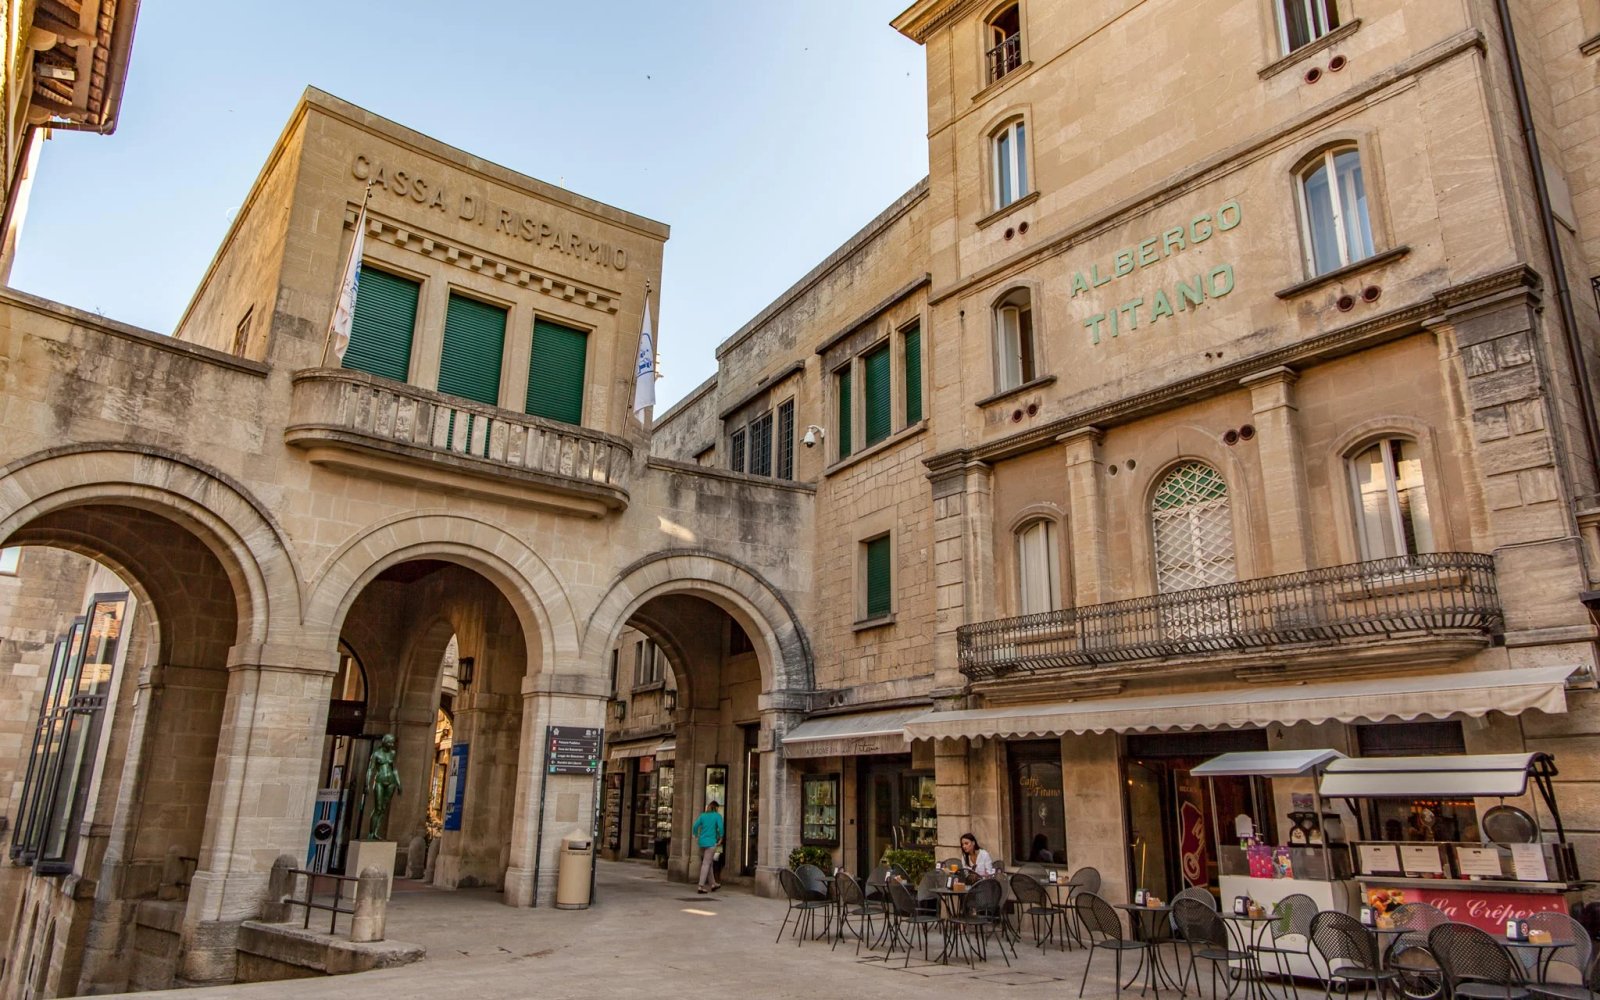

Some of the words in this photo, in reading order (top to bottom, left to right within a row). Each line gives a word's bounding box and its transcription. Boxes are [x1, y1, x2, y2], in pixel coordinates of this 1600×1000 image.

[352, 155, 447, 212] CASSA
[459, 196, 488, 225] DI
[496, 209, 627, 271] RISPARMIO
[1070, 200, 1241, 298] ALBERGO
[1084, 263, 1234, 344] TITANO
[1276, 729, 1284, 740] 4
[1431, 897, 1458, 916] La
